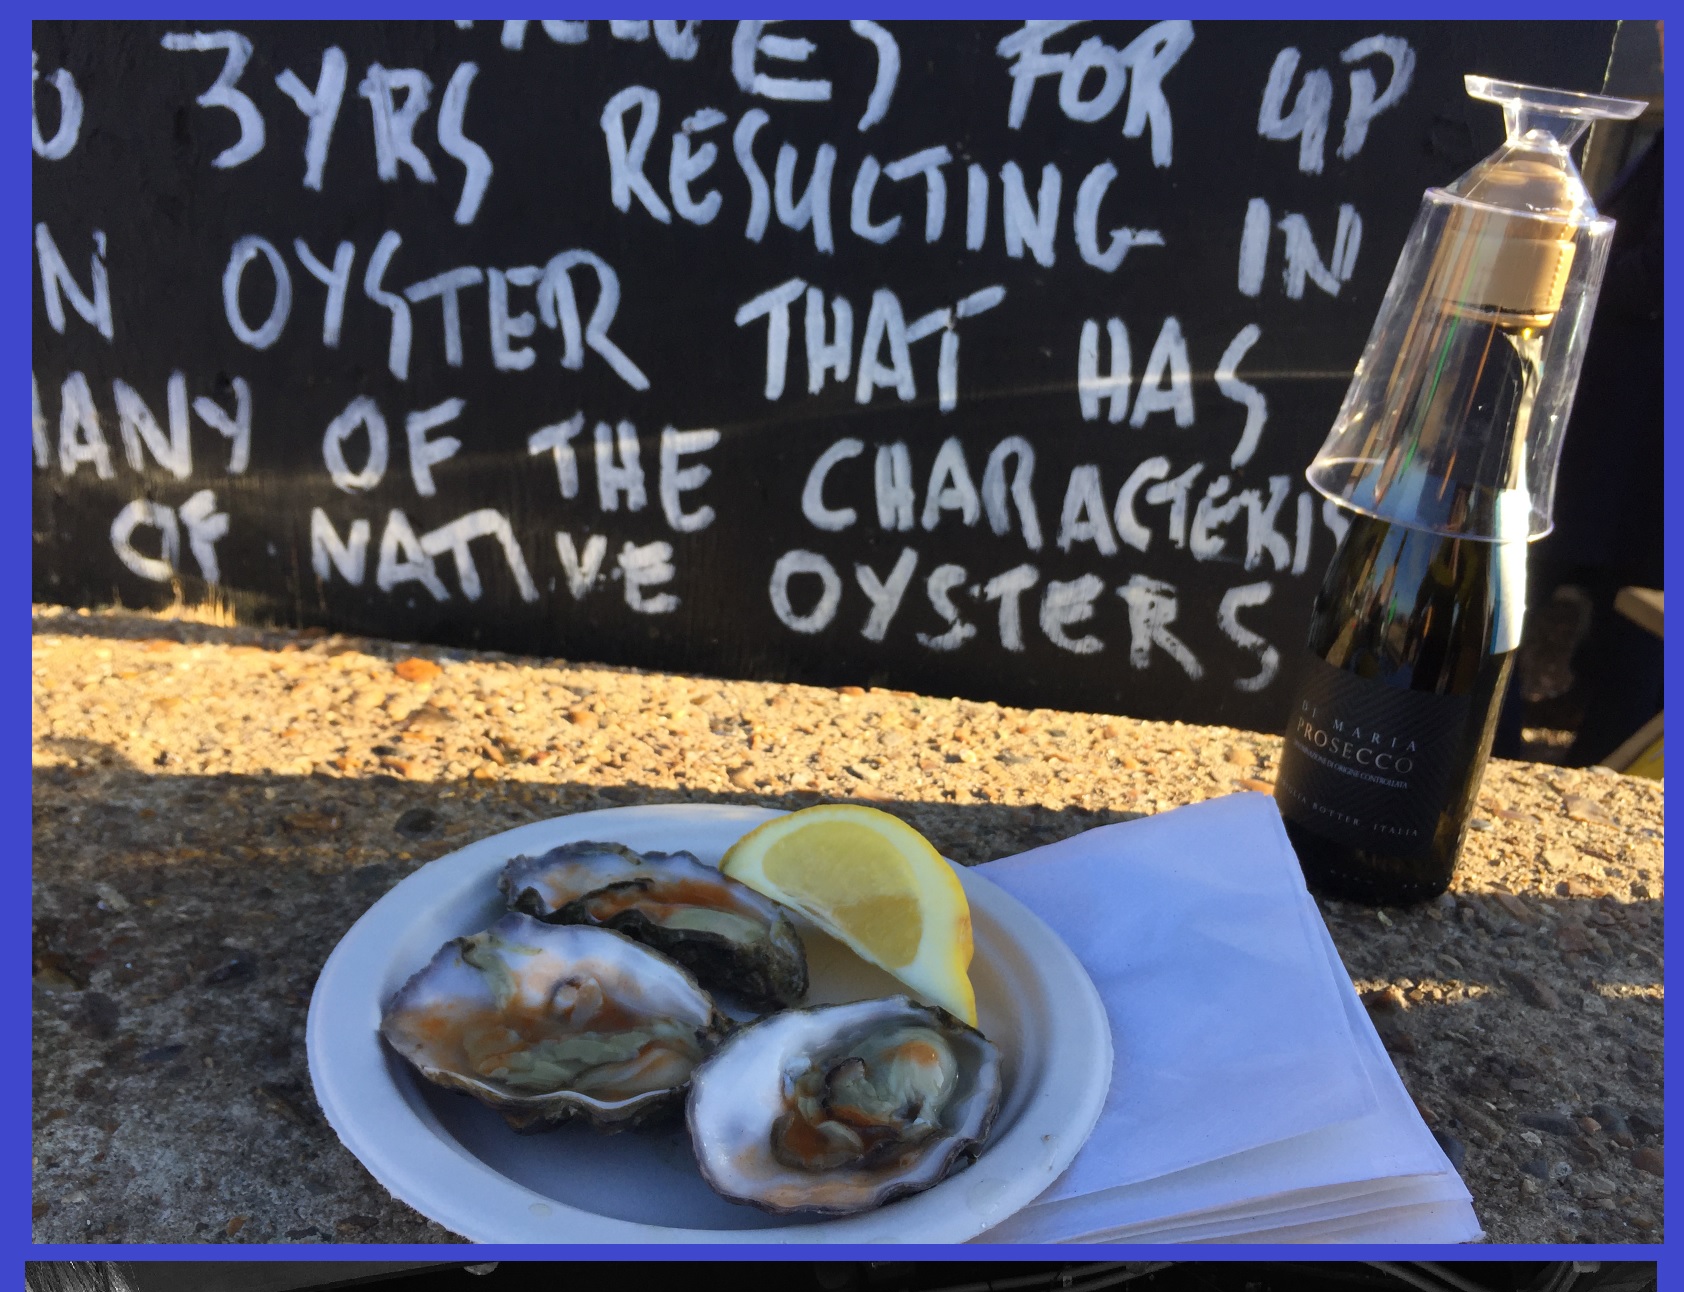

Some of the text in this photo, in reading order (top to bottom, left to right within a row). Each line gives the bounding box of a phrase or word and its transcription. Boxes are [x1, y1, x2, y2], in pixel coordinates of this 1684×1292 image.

[996, 20, 1194, 168] FOR
[1238, 197, 1362, 299] IN
[222, 229, 650, 391] OYSTER
[735, 278, 1006, 413] THAT
[1078, 316, 1267, 468] HAS
[323, 397, 465, 496] OF
[529, 411, 720, 532] THE
[110, 489, 1280, 692] OF NATIVE OYSTERS
[1297, 716, 1413, 774] PROSECCO
[1333, 719, 1417, 752] MARIA
[1373, 822, 1419, 838] ITALIA
